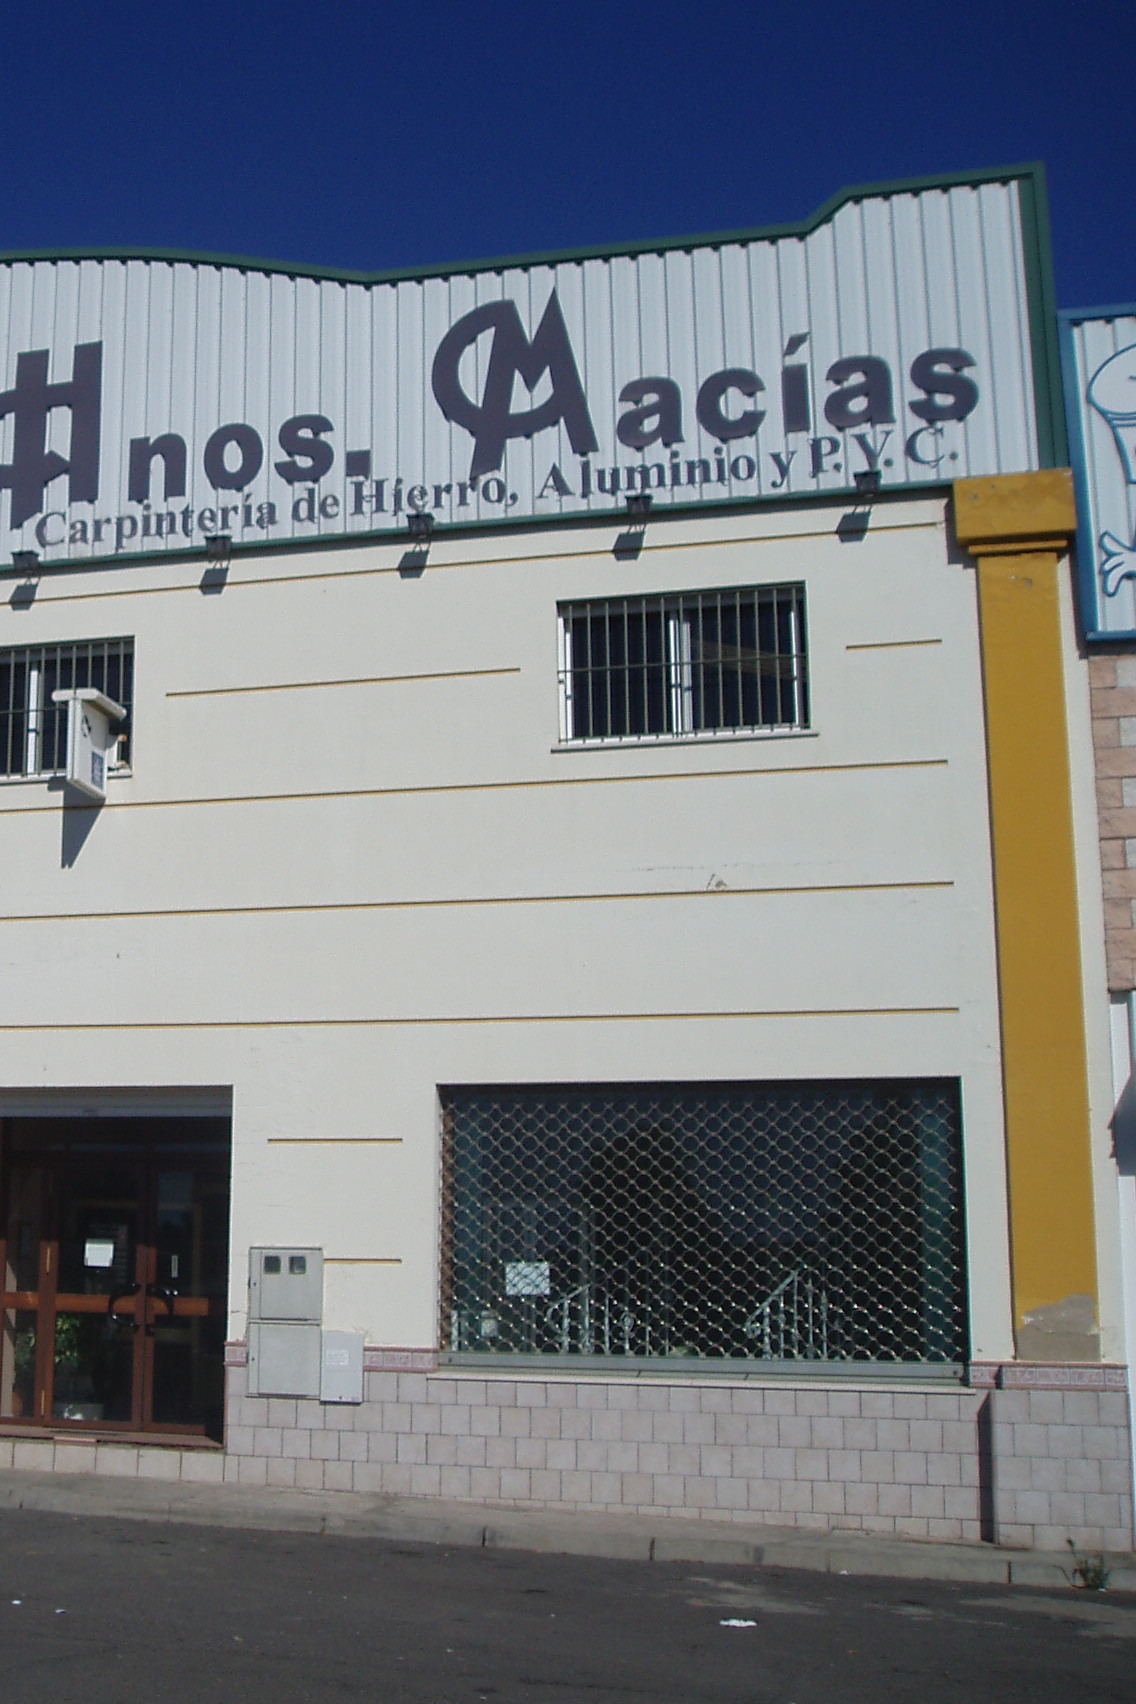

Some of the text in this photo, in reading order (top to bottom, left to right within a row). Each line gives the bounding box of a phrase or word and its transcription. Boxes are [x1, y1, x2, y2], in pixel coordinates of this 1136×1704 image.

[35, 491, 278, 550] Carpintería
[291, 487, 340, 523] de
[349, 476, 519, 517] Hierro,
[536, 446, 756, 498] Aluminio
[769, 450, 797, 488] y
